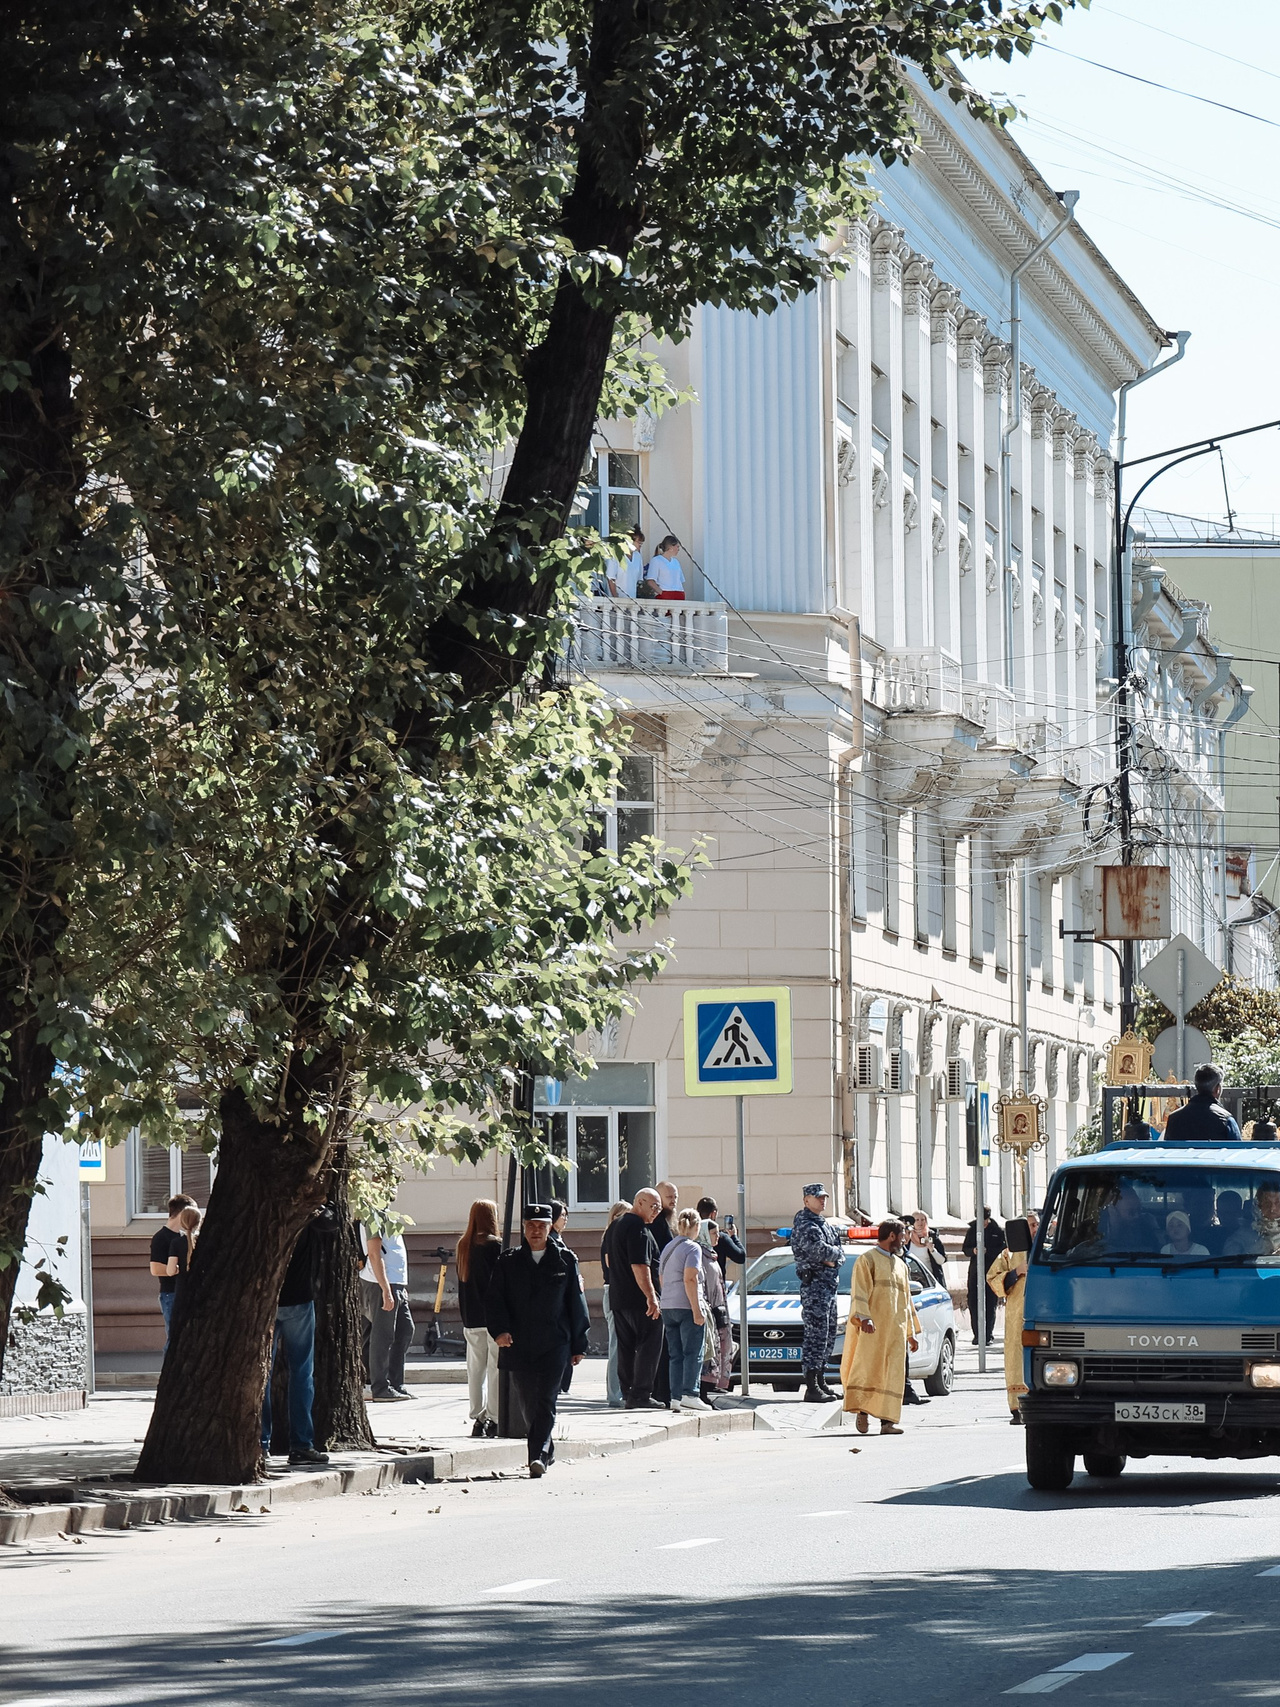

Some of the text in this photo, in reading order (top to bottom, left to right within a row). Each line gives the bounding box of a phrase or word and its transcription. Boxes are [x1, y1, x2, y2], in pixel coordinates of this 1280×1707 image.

[747, 1300, 801, 1311] ДП
[1127, 1335, 1199, 1347] TOYOTA
[1185, 1405, 1200, 1416] 38
